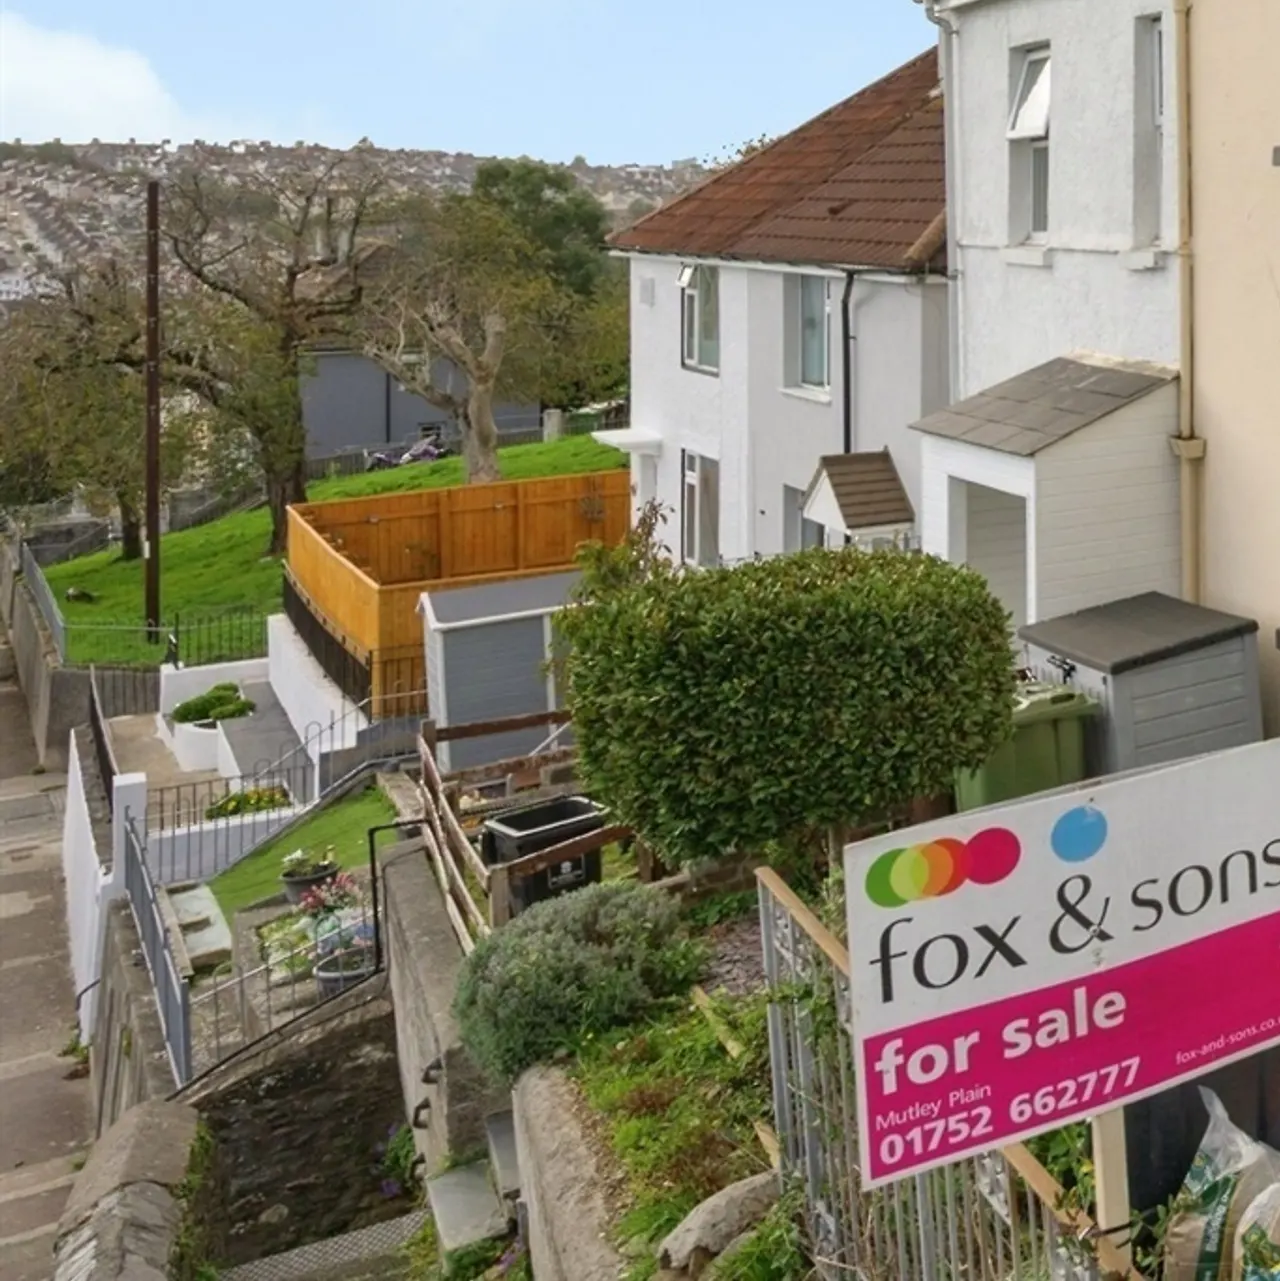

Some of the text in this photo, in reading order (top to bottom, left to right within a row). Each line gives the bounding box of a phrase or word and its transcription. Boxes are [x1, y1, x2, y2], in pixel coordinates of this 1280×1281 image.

[869, 917, 1027, 1004] fox
[1048, 873, 1115, 955] &
[874, 986, 1128, 1096] for sale
[875, 1083, 992, 1131] Mutley Plain
[879, 1055, 1142, 1166] 01752 662777
